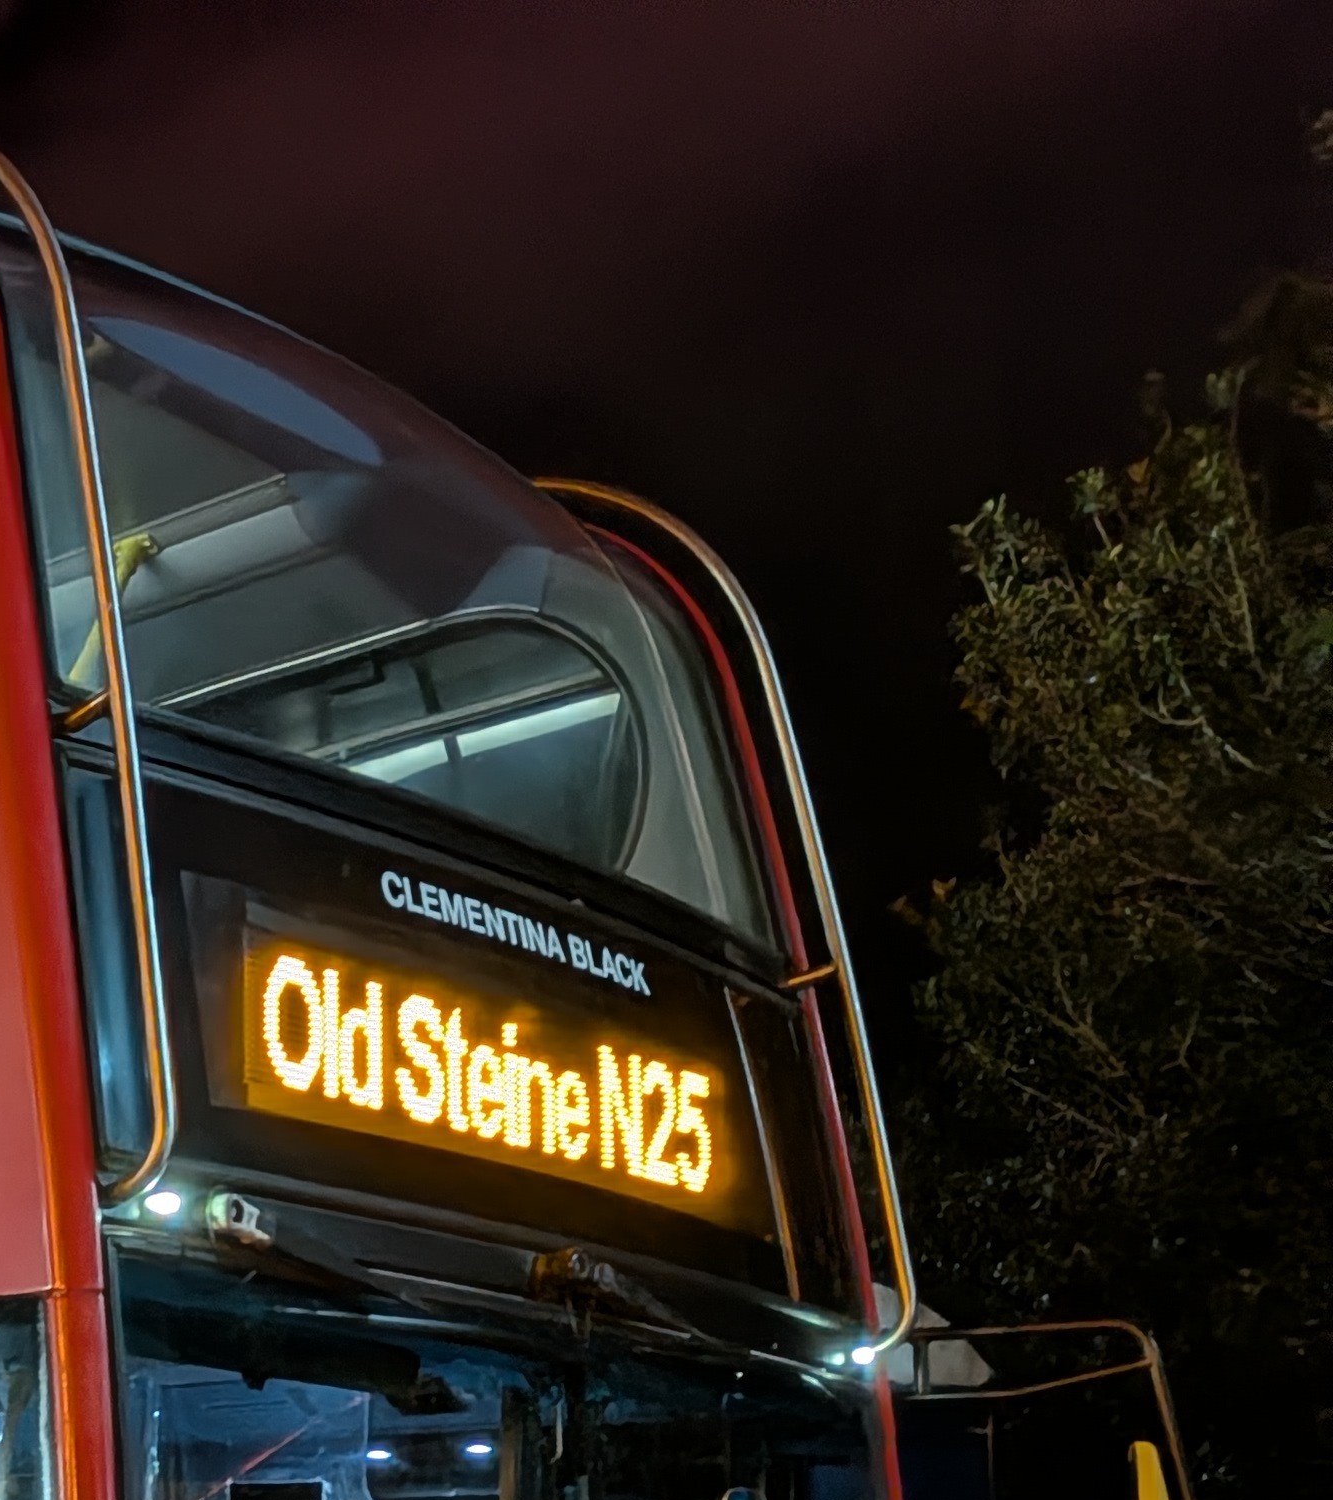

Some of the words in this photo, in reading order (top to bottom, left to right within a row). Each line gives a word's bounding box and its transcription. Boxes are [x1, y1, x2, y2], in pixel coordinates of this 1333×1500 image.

[380, 869, 566, 964] CLEMENTINA
[567, 932, 652, 997] BLACK
[262, 954, 384, 1111] Old
[394, 993, 591, 1161] Steine
[597, 1044, 713, 1194] N25
